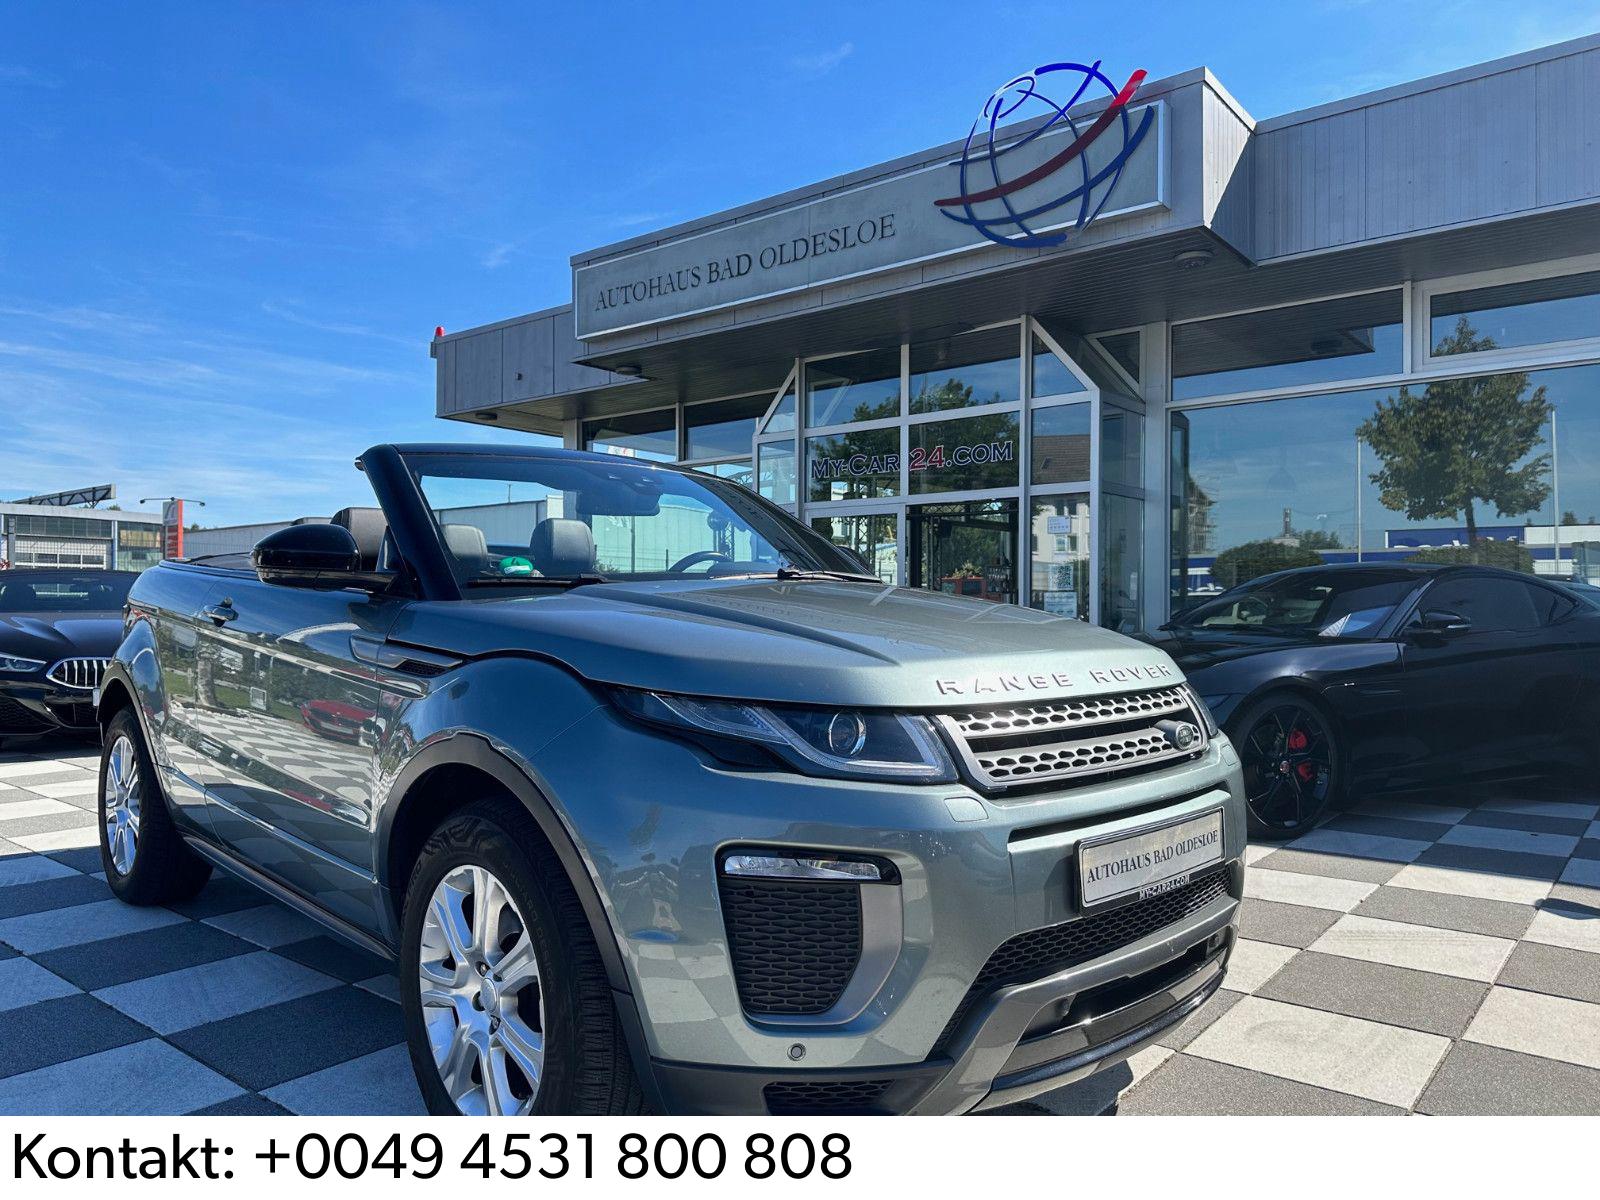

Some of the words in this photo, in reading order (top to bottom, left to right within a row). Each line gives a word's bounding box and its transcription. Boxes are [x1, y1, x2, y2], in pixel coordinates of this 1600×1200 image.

[595, 264, 702, 312] AUTOHAUS
[706, 253, 753, 285] BAD
[758, 213, 897, 271] OLDESLOE
[935, 671, 1074, 696] RANGE
[1088, 662, 1173, 685] ROVER
[1086, 852, 1152, 884] AUTOHAUS
[1152, 845, 1175, 865] BAD
